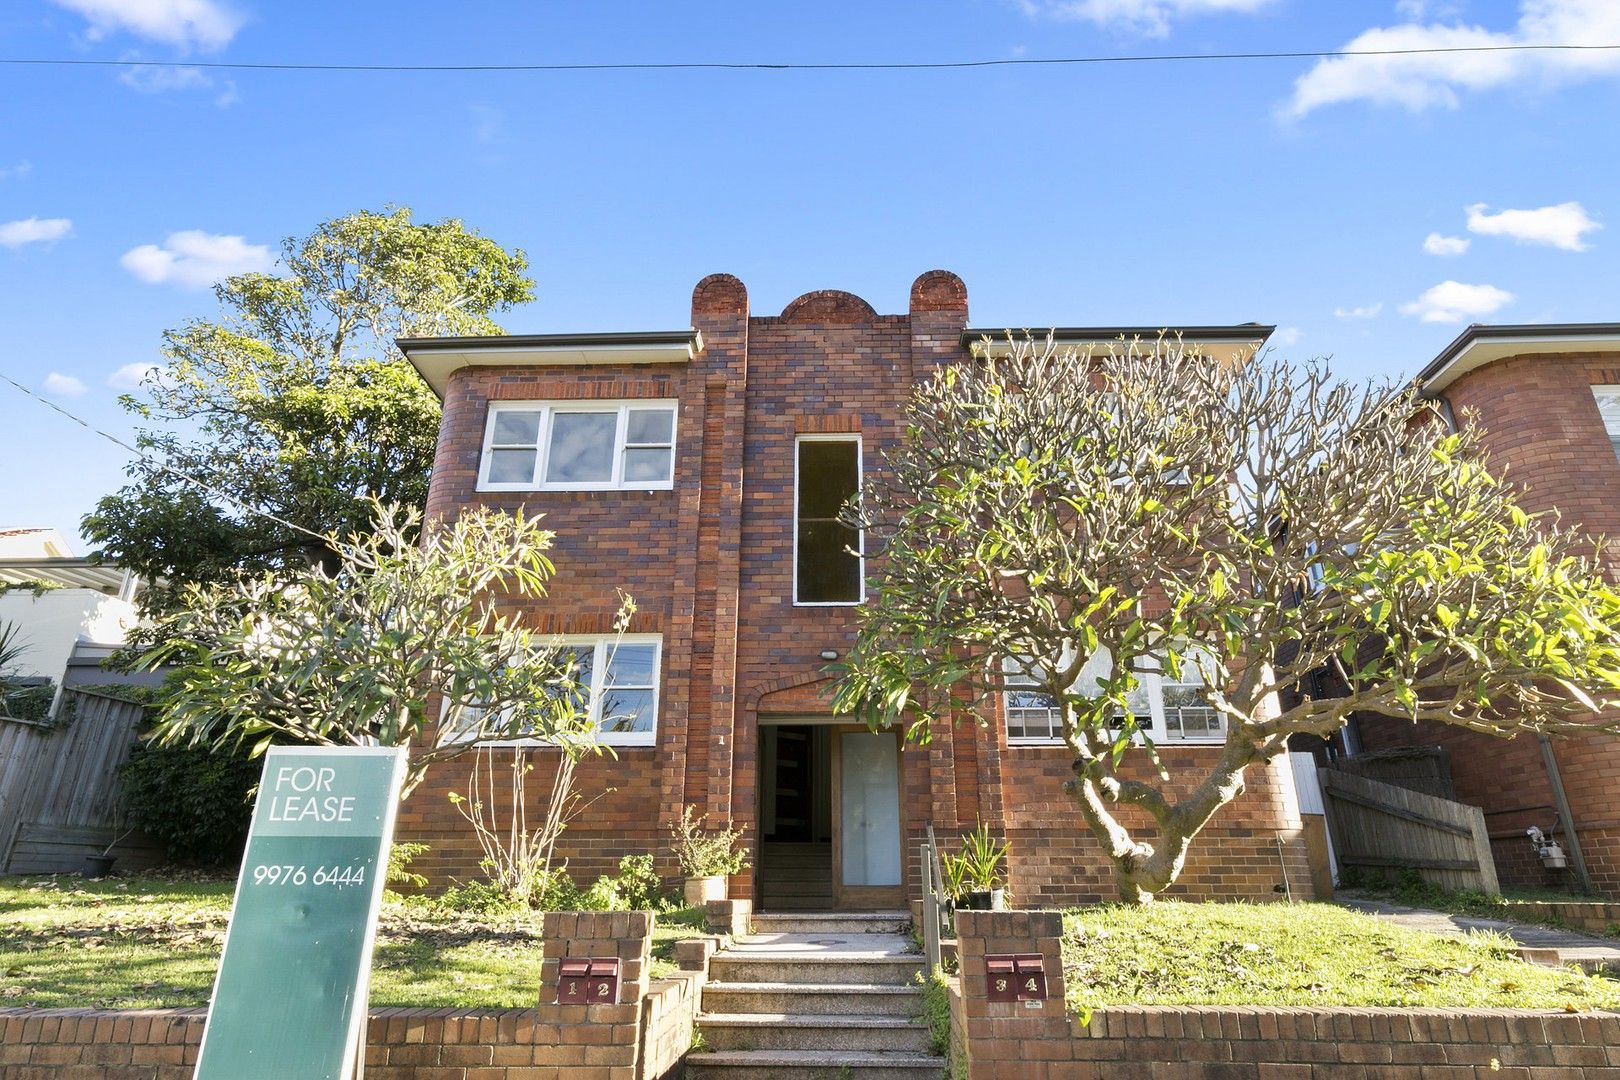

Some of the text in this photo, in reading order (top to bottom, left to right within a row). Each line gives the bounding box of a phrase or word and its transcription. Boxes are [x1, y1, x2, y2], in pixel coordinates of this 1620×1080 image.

[275, 767, 336, 792] FOR
[268, 796, 356, 822] LEASE
[253, 865, 365, 886] 9976 6444
[568, 982, 577, 995] 1
[597, 983, 609, 997] 2
[995, 979, 1007, 992] 3
[1024, 977, 1038, 992] 4
